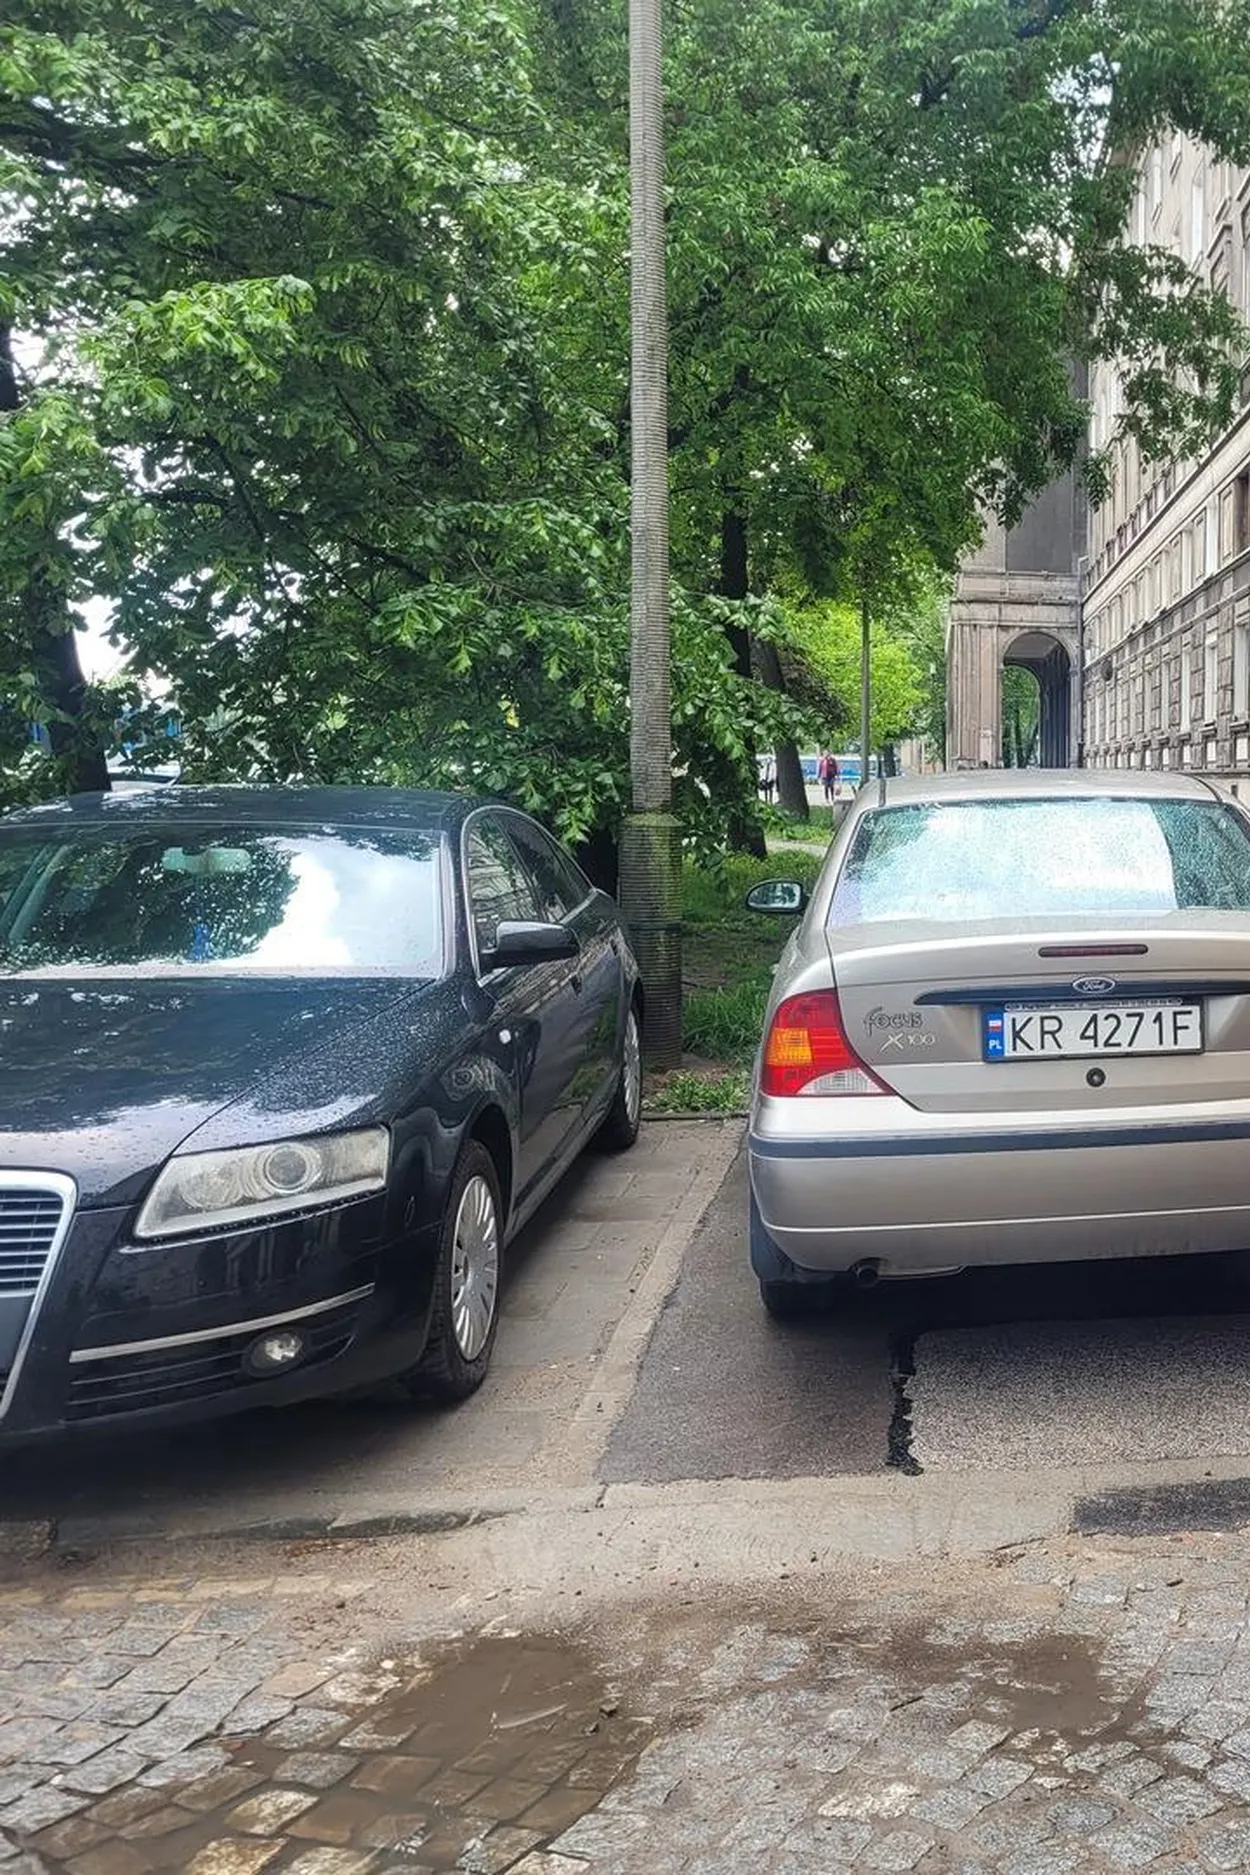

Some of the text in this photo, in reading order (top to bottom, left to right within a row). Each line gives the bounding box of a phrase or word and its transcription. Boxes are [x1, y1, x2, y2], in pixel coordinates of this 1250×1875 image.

[1011, 1010, 1193, 1051] KR 4271F
[989, 1039, 1003, 1050] PL
